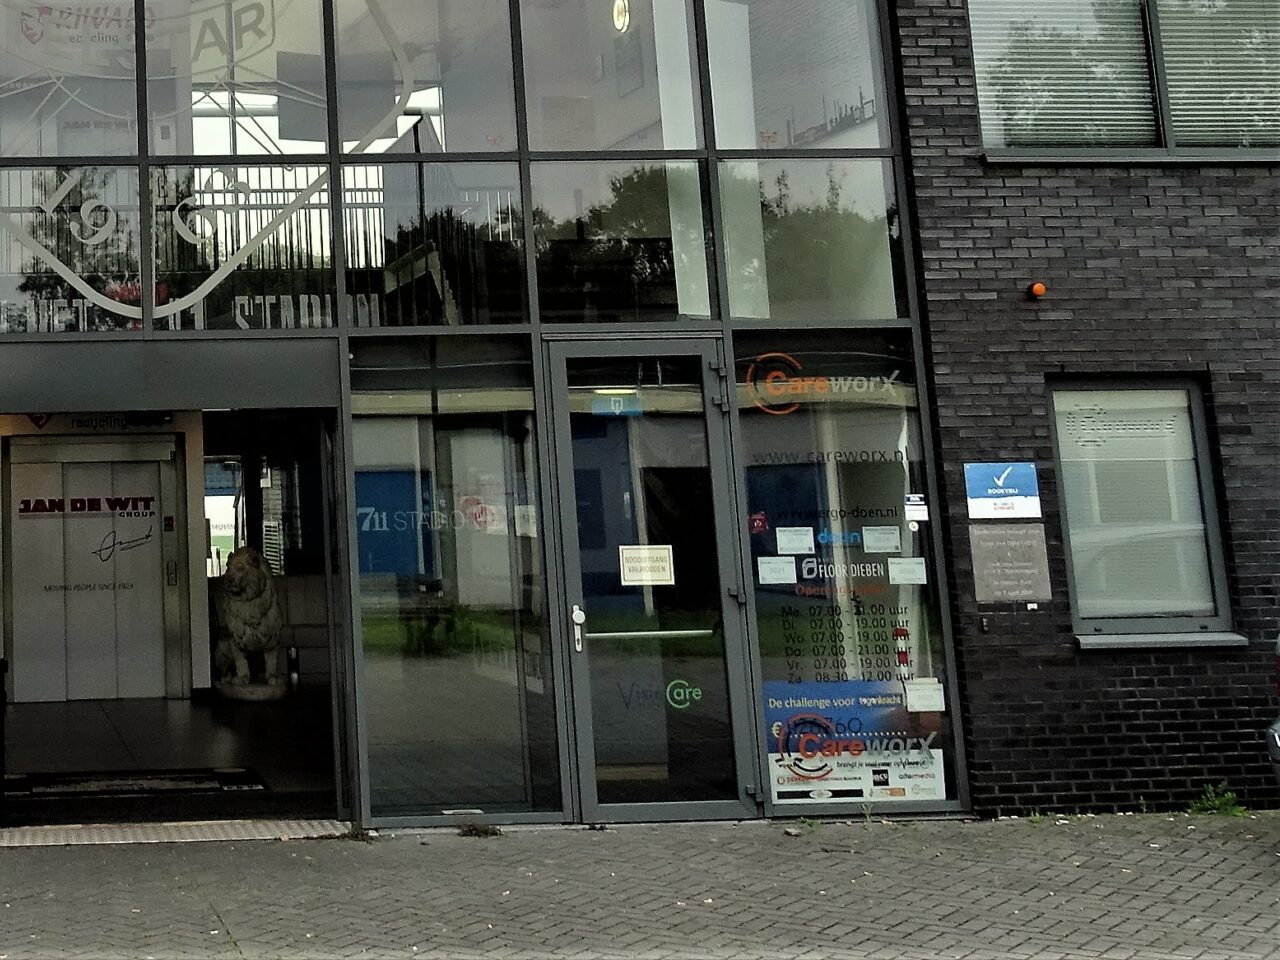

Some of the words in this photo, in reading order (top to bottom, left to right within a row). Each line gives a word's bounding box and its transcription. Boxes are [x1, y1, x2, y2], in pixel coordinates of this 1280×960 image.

[19, 499, 65, 513] JAN
[70, 498, 102, 512] DE
[105, 496, 156, 511] WIT
[818, 563, 849, 579] FLOOR
[850, 562, 885, 578] DIEBEN
[768, 698, 783, 708] De
[785, 697, 830, 709] challenge
[832, 698, 855, 707] voor
